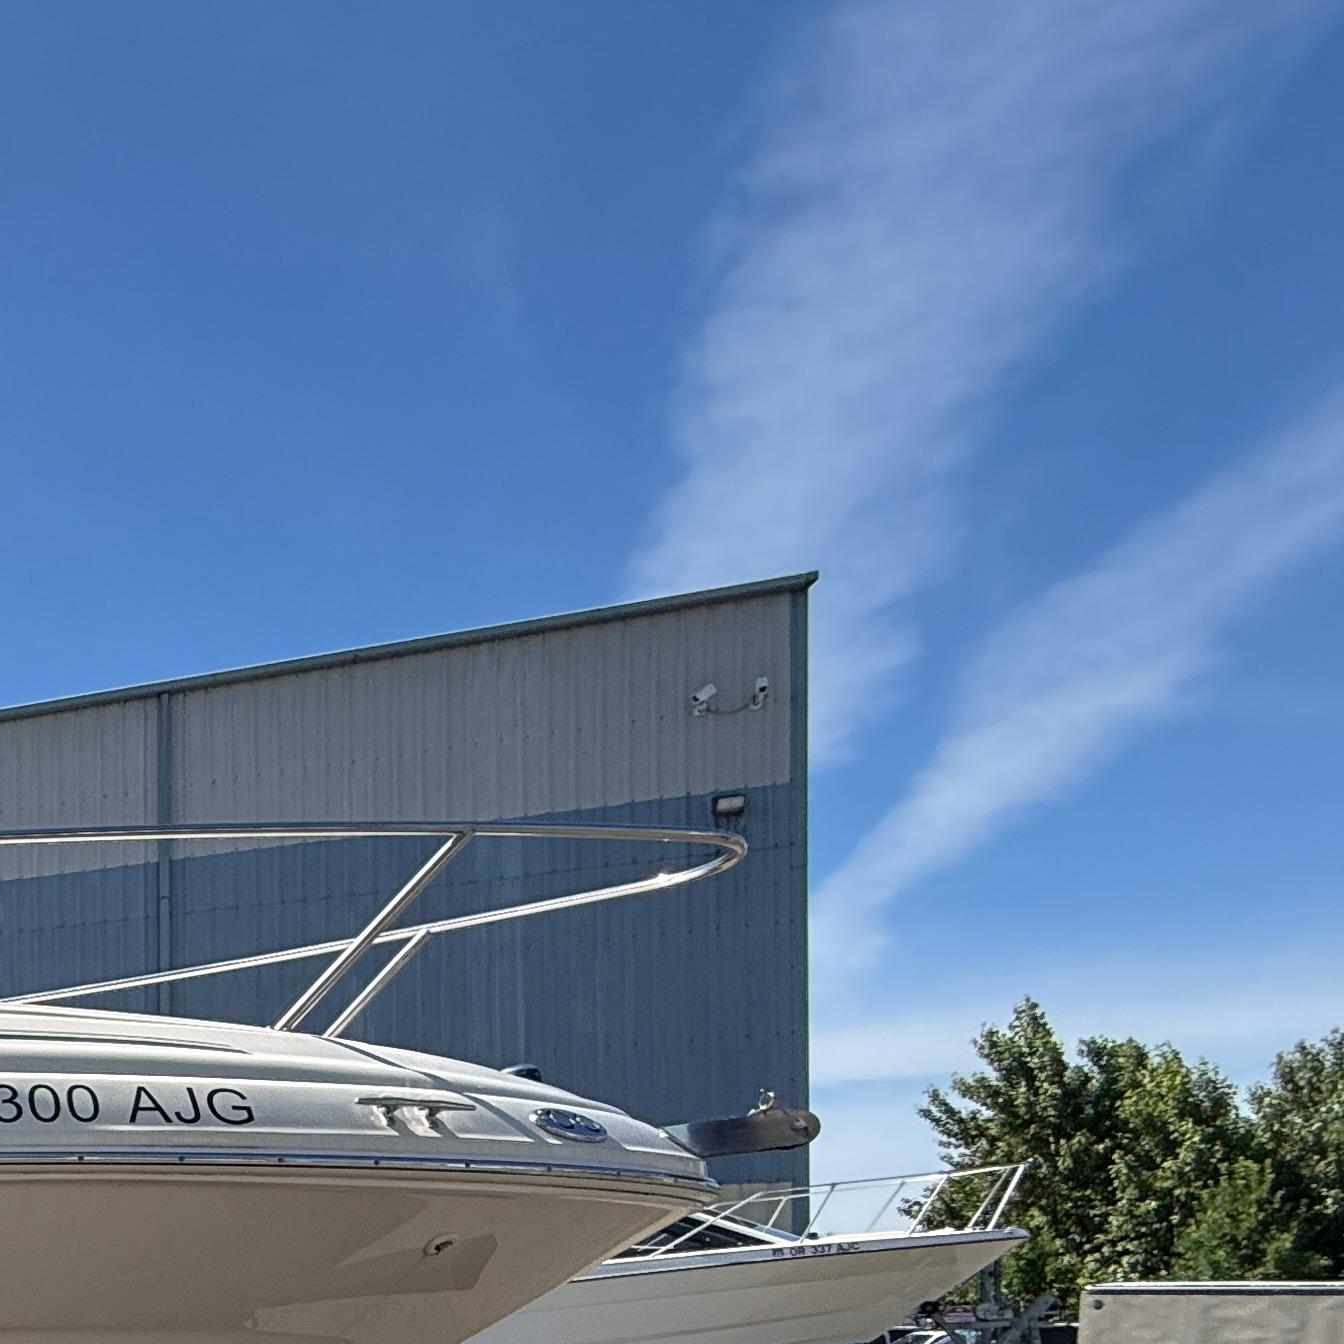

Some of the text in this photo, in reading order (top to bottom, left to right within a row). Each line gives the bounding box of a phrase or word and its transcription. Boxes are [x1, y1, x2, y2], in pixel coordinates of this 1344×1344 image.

[128, 1086, 255, 1126] AJG
[789, 1246, 806, 1257] OR
[812, 1244, 832, 1255] 337
